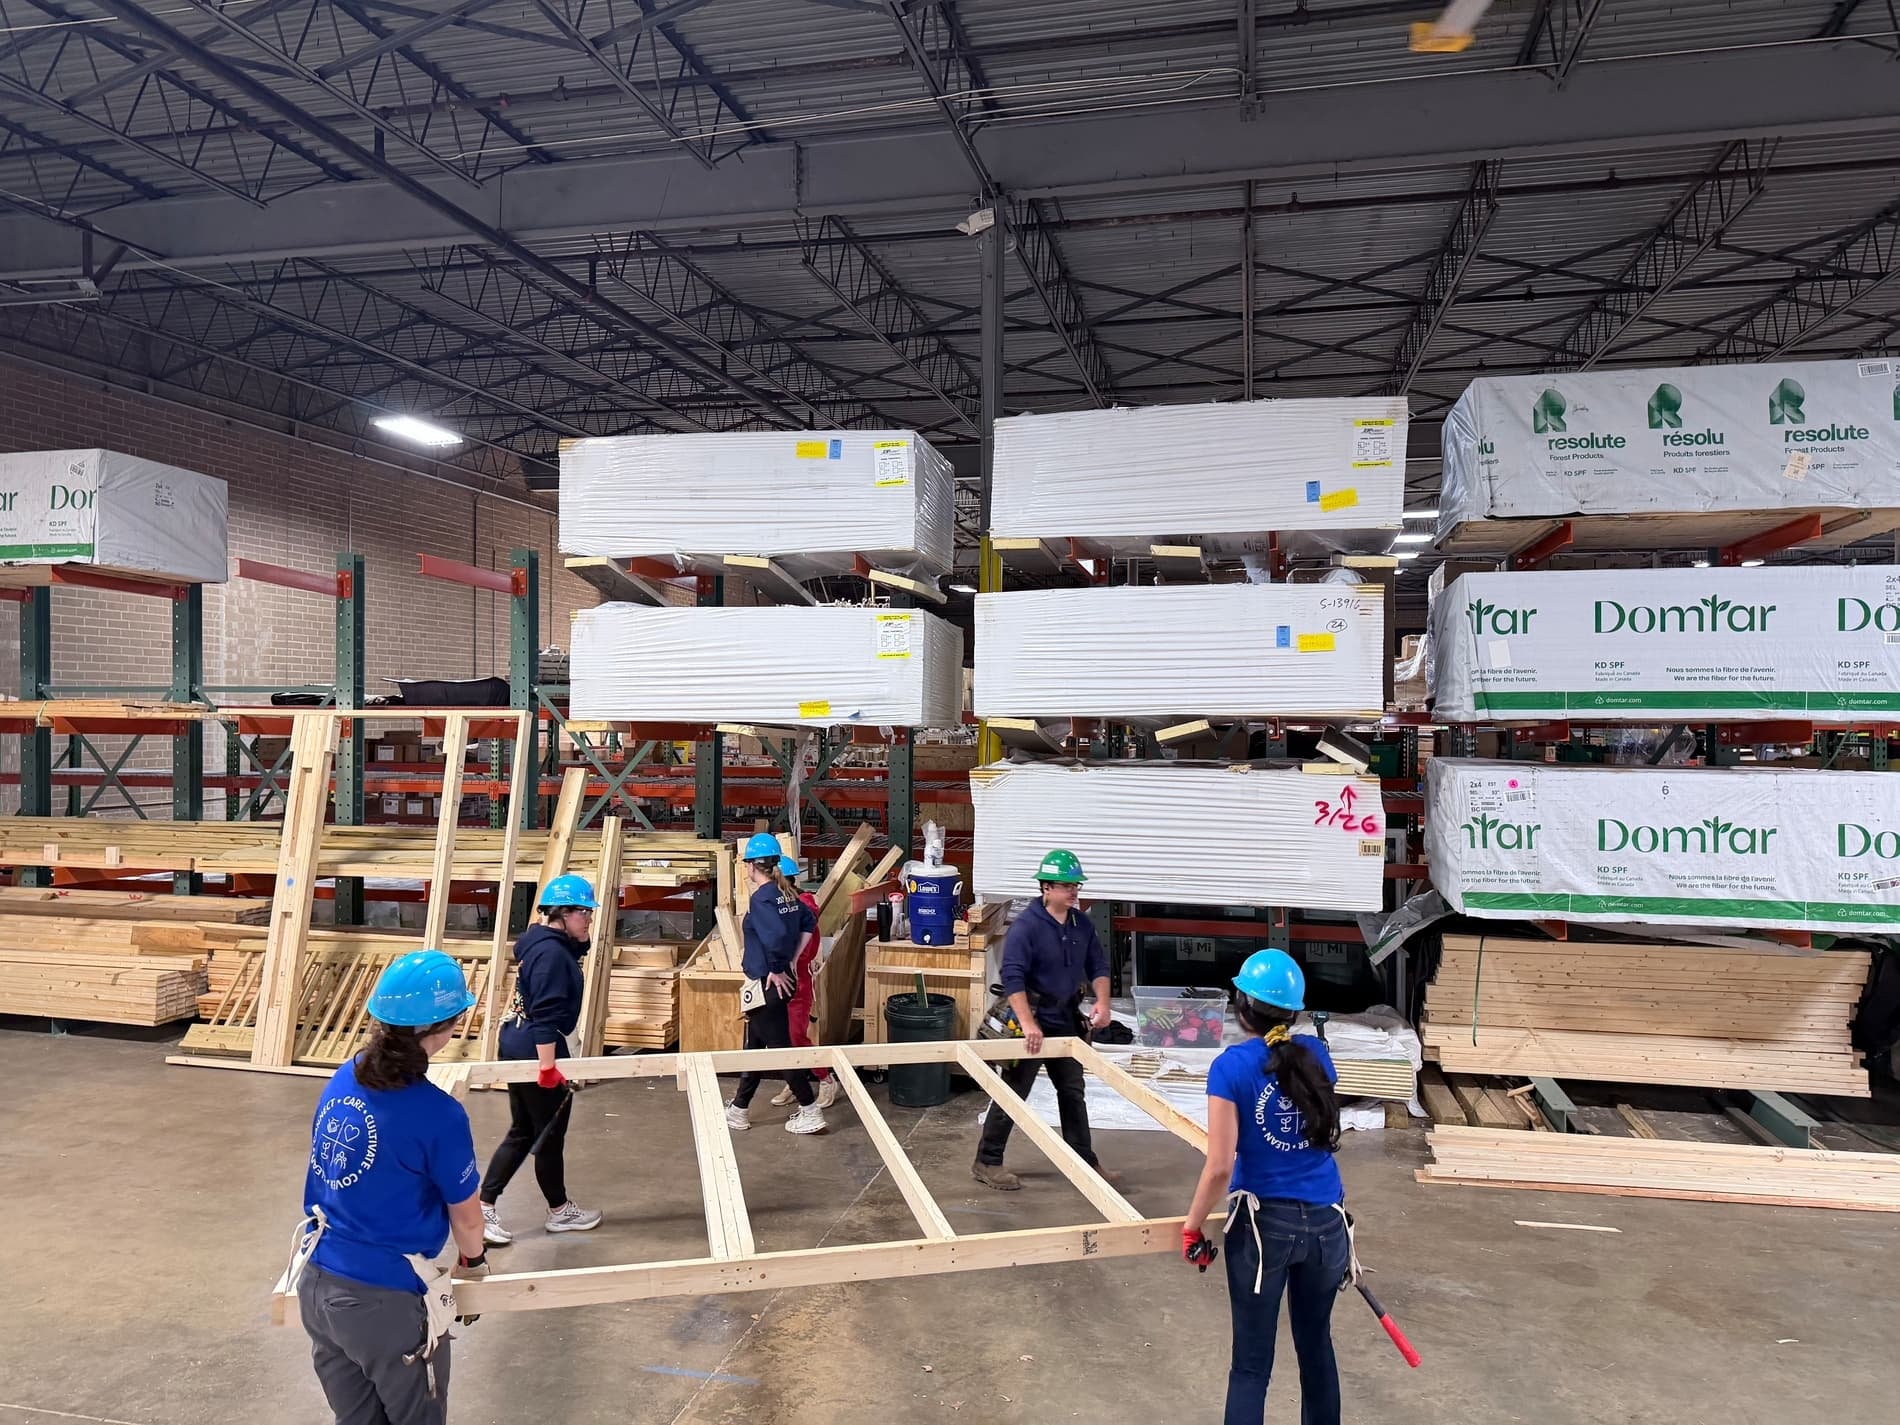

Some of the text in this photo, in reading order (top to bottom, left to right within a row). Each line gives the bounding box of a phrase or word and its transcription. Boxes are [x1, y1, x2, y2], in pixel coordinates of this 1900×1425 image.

[1663, 428, 1724, 447] résolu
[1784, 423, 1870, 443] resolute
[1548, 432, 1626, 450] resolute
[1663, 449, 1731, 458] Produits forestiers
[1810, 445, 1845, 454] Products
[1549, 452, 1605, 462] Forest Products
[1466, 598, 1538, 635] tar
[1594, 593, 1777, 634] Domtar
[1594, 661, 1625, 669] KD SPF
[1666, 666, 1684, 674] Nous
[1838, 661, 1871, 669] KD SPF
[1711, 674, 1728, 682] fiber
[1605, 696, 1642, 704] domtar.com
[1661, 785, 1670, 796] 6
[1314, 800, 1377, 833] 3/26
[1598, 815, 1778, 855] Domtar
[1597, 865, 1628, 874] KD SPF
[1838, 872, 1869, 880] KD SPF
[1255, 1082, 1275, 1125] CONNECT
[343, 1096, 366, 1111] CARE
[361, 1114, 378, 1170] CULTIVATE
[1264, 1132, 1291, 1152] CLEAN
